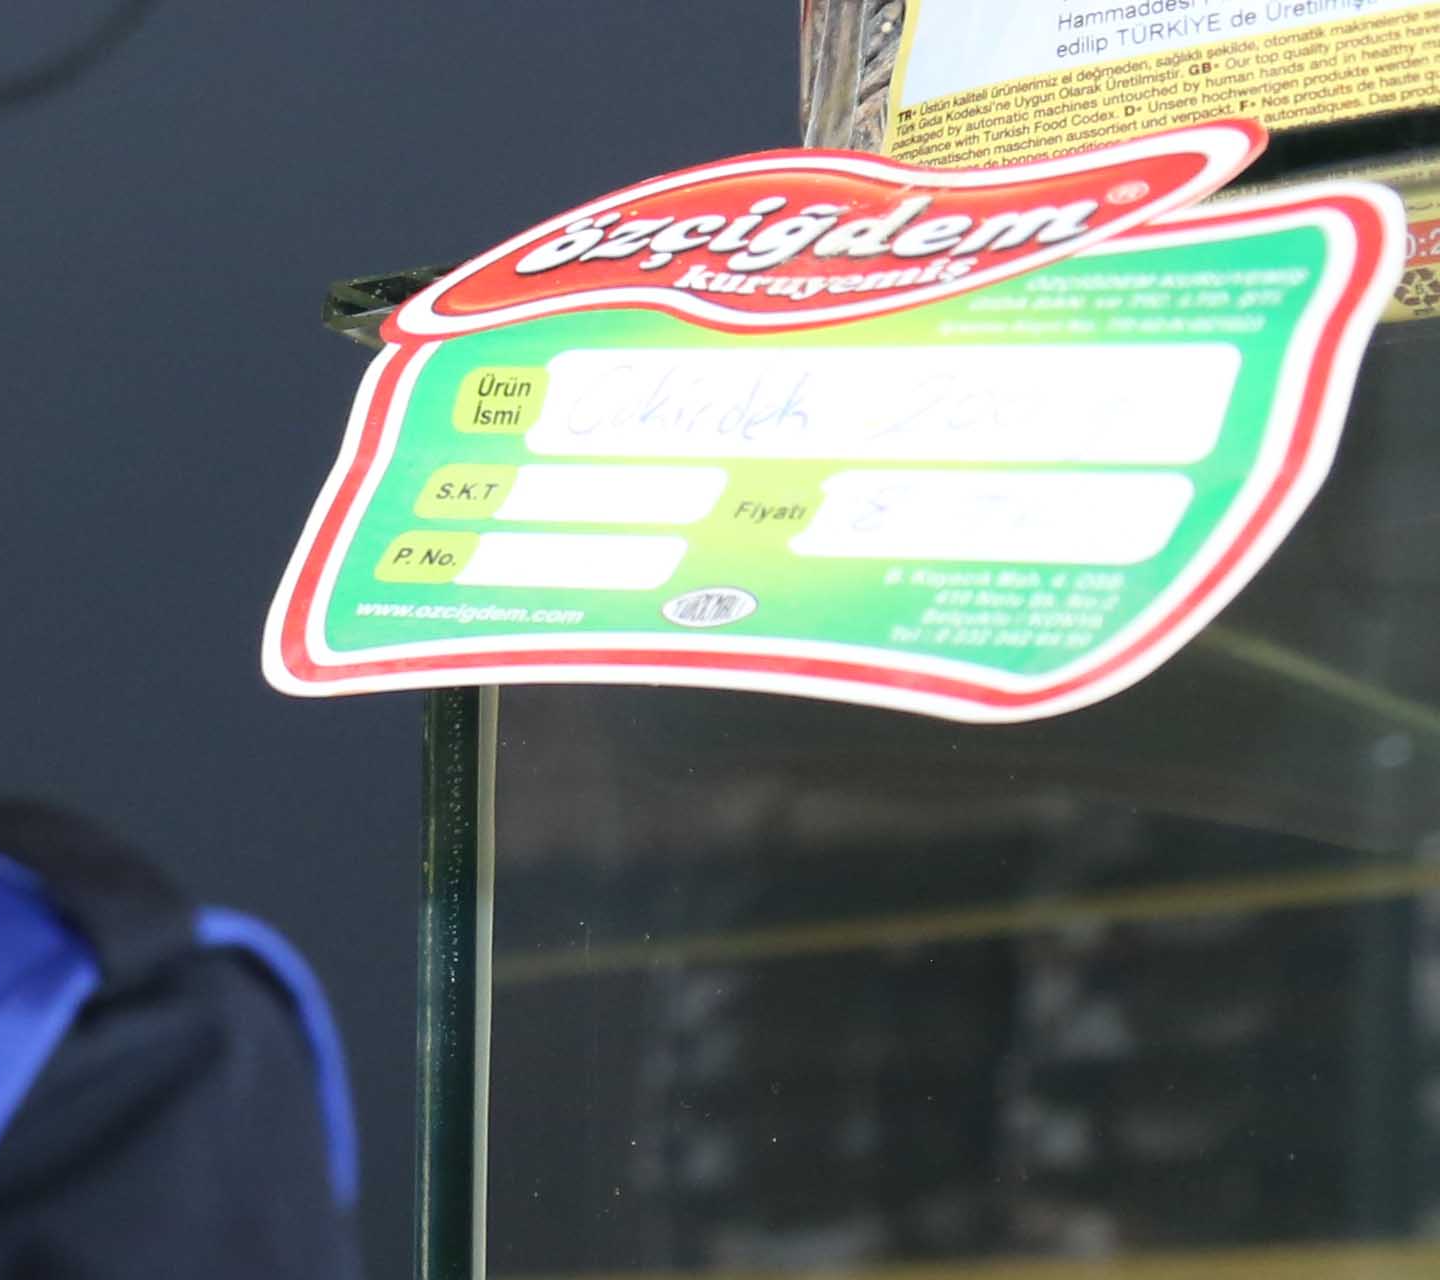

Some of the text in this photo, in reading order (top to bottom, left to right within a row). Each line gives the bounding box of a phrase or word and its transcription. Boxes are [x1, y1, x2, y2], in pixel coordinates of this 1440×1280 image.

[1056, 34, 1109, 58] edilip
[1117, 13, 1222, 47] TÜRKİYE
[1231, 10, 1257, 28] de
[1034, 99, 1098, 120] machines
[1034, 118, 1067, 134] Food
[674, 256, 978, 299] kuruyemiş
[477, 373, 532, 398] Ürün
[472, 401, 522, 426] İsmi
[436, 483, 499, 501] S.K.T
[734, 502, 807, 524] Fiyatı
[393, 548, 458, 567] P. No.
[356, 601, 584, 626] www.ozcigdem.com
